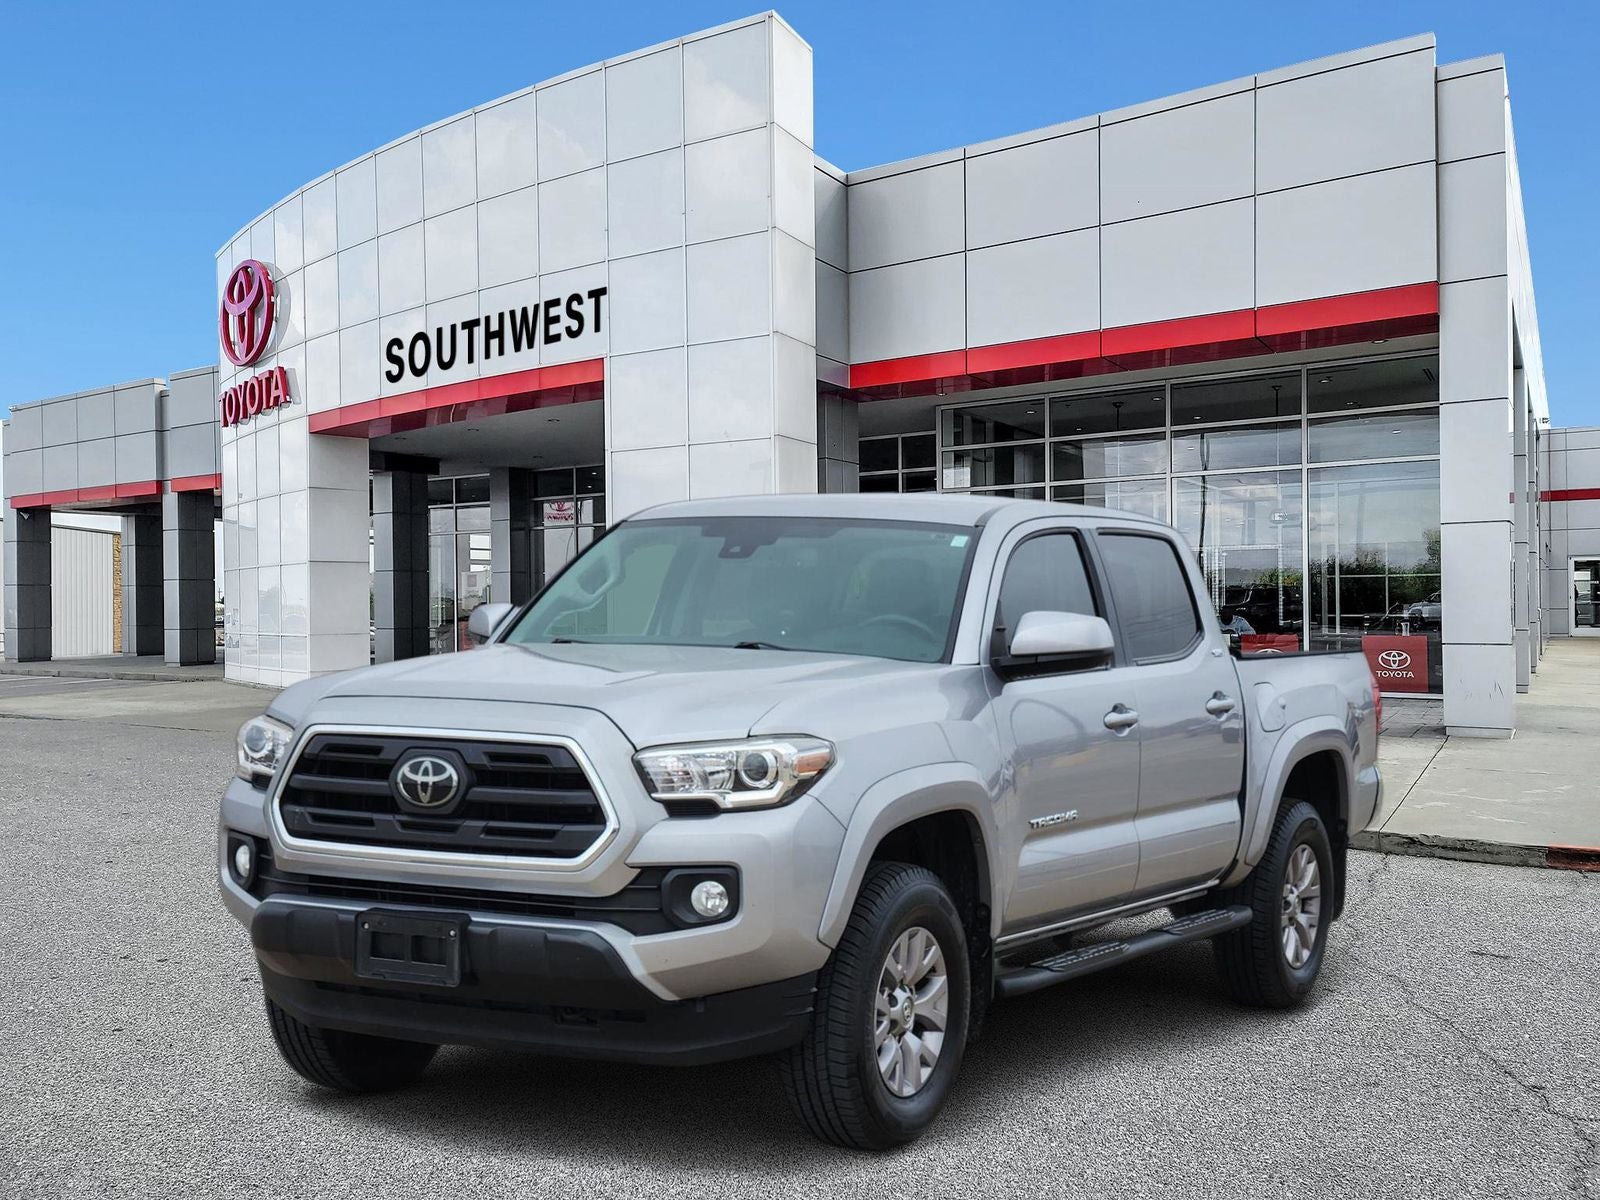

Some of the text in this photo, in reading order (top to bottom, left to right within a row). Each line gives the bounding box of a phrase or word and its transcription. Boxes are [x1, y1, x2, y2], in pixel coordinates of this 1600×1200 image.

[385, 286, 607, 383] SOUTHWEST
[218, 366, 290, 428] TOYOTA
[1376, 670, 1415, 678] TOYOTA
[1028, 810, 1079, 828] TACOMA
